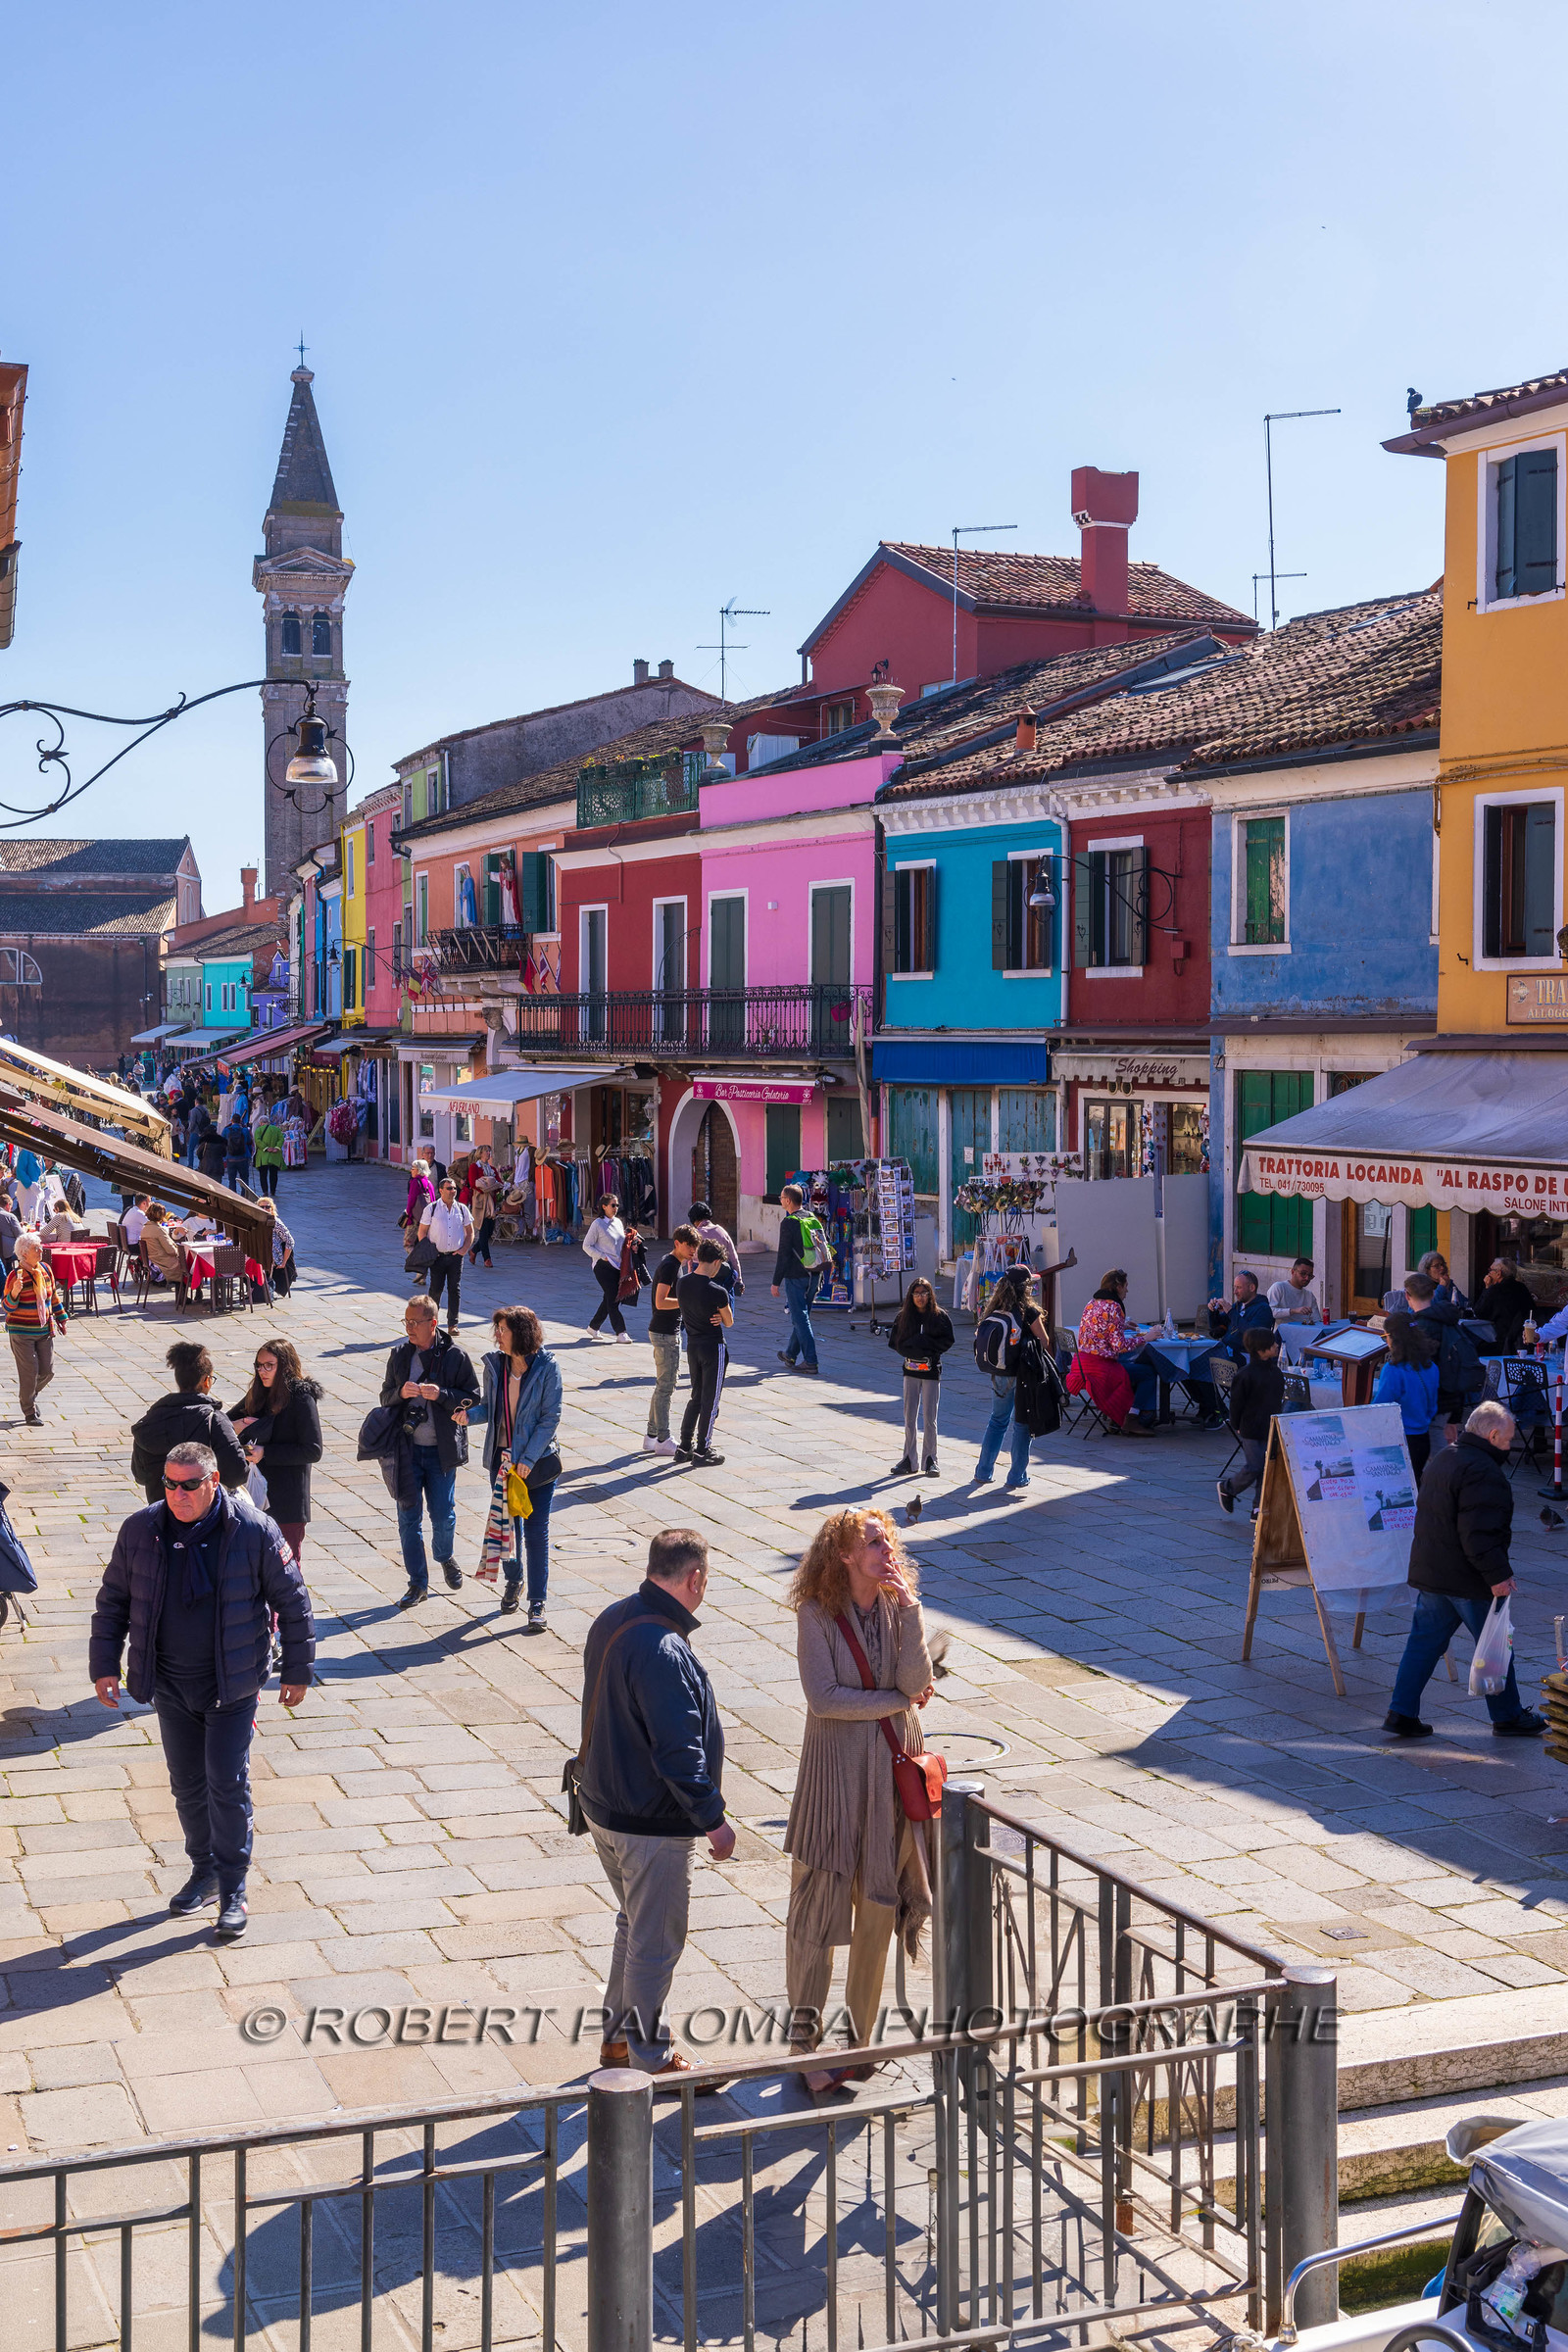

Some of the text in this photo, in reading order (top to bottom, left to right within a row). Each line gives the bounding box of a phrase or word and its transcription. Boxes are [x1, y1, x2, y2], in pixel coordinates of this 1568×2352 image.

[1536, 979, 1568, 1005] TRA
[714, 1083, 727, 1098] Bar
[448, 1101, 480, 1114] NEVERLAND
[1259, 1156, 1340, 1178] TRATTORIA
[1348, 1163, 1423, 1185] LOCANDA
[1467, 1171, 1529, 1194] RASPO
[1534, 1175, 1558, 1196] DE
[1259, 1177, 1275, 1190] TEL.
[1503, 1197, 1568, 1212] SALONE INT
